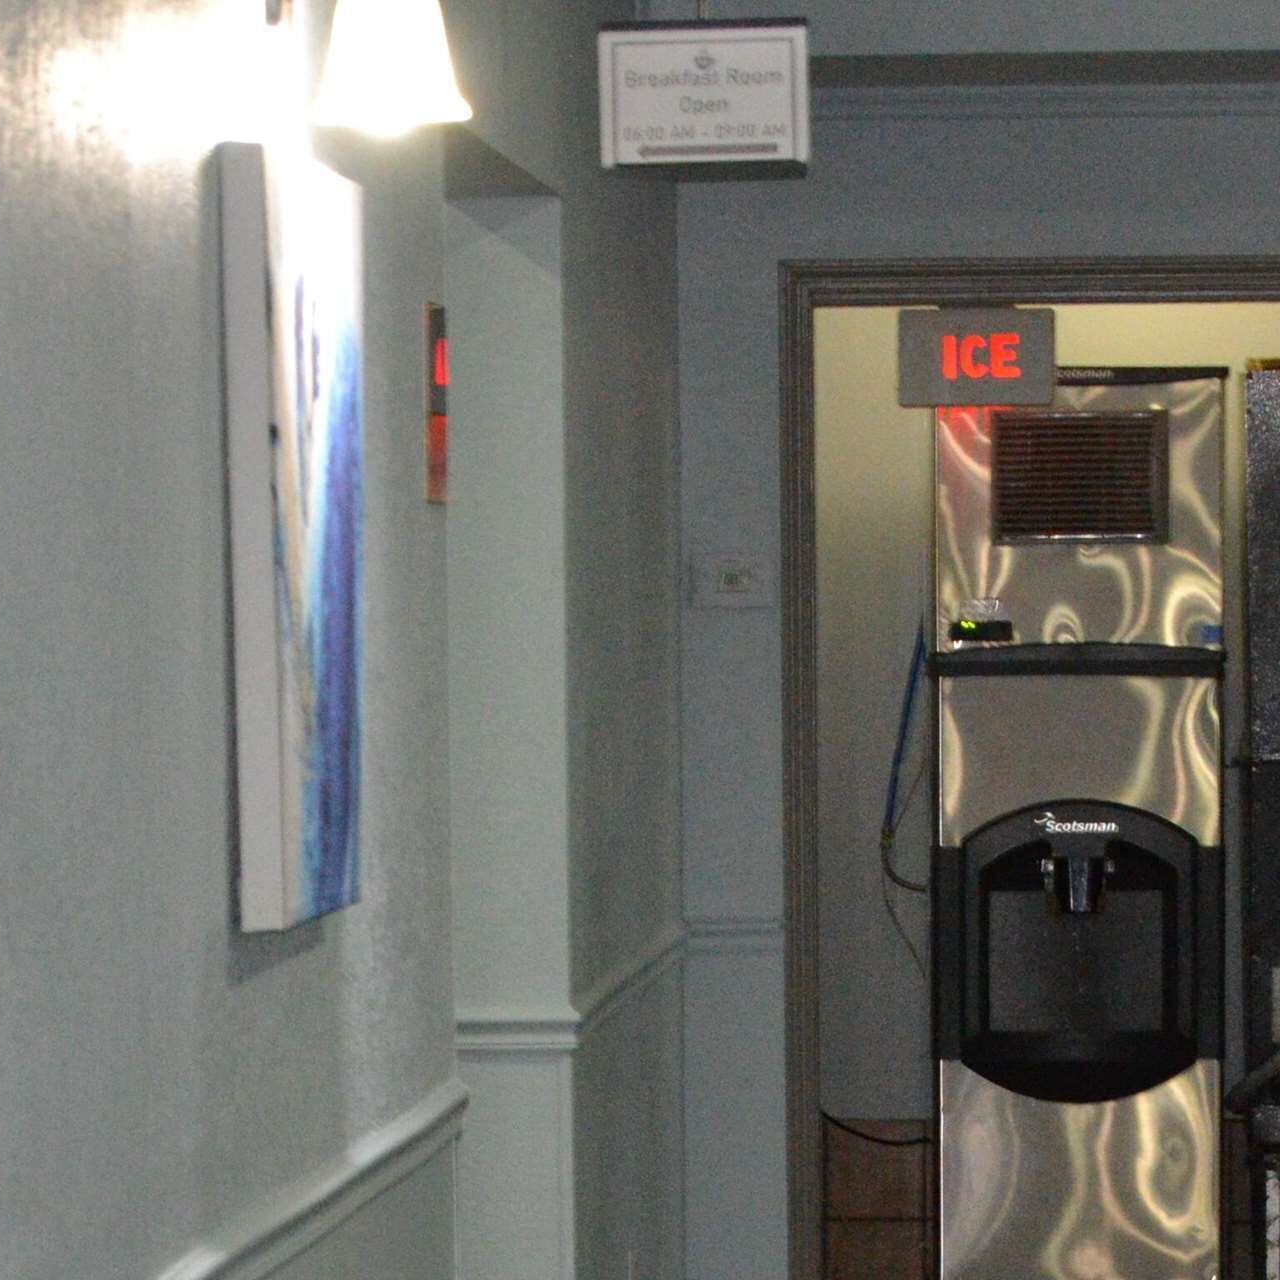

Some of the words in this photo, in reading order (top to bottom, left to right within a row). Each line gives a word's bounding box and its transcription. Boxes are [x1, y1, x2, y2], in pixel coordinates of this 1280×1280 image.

[624, 69, 719, 88] Breakfast
[726, 68, 782, 86] Room
[679, 95, 729, 114] Open
[942, 332, 1022, 381] ICE
[1046, 820, 1115, 832] Scotsman
